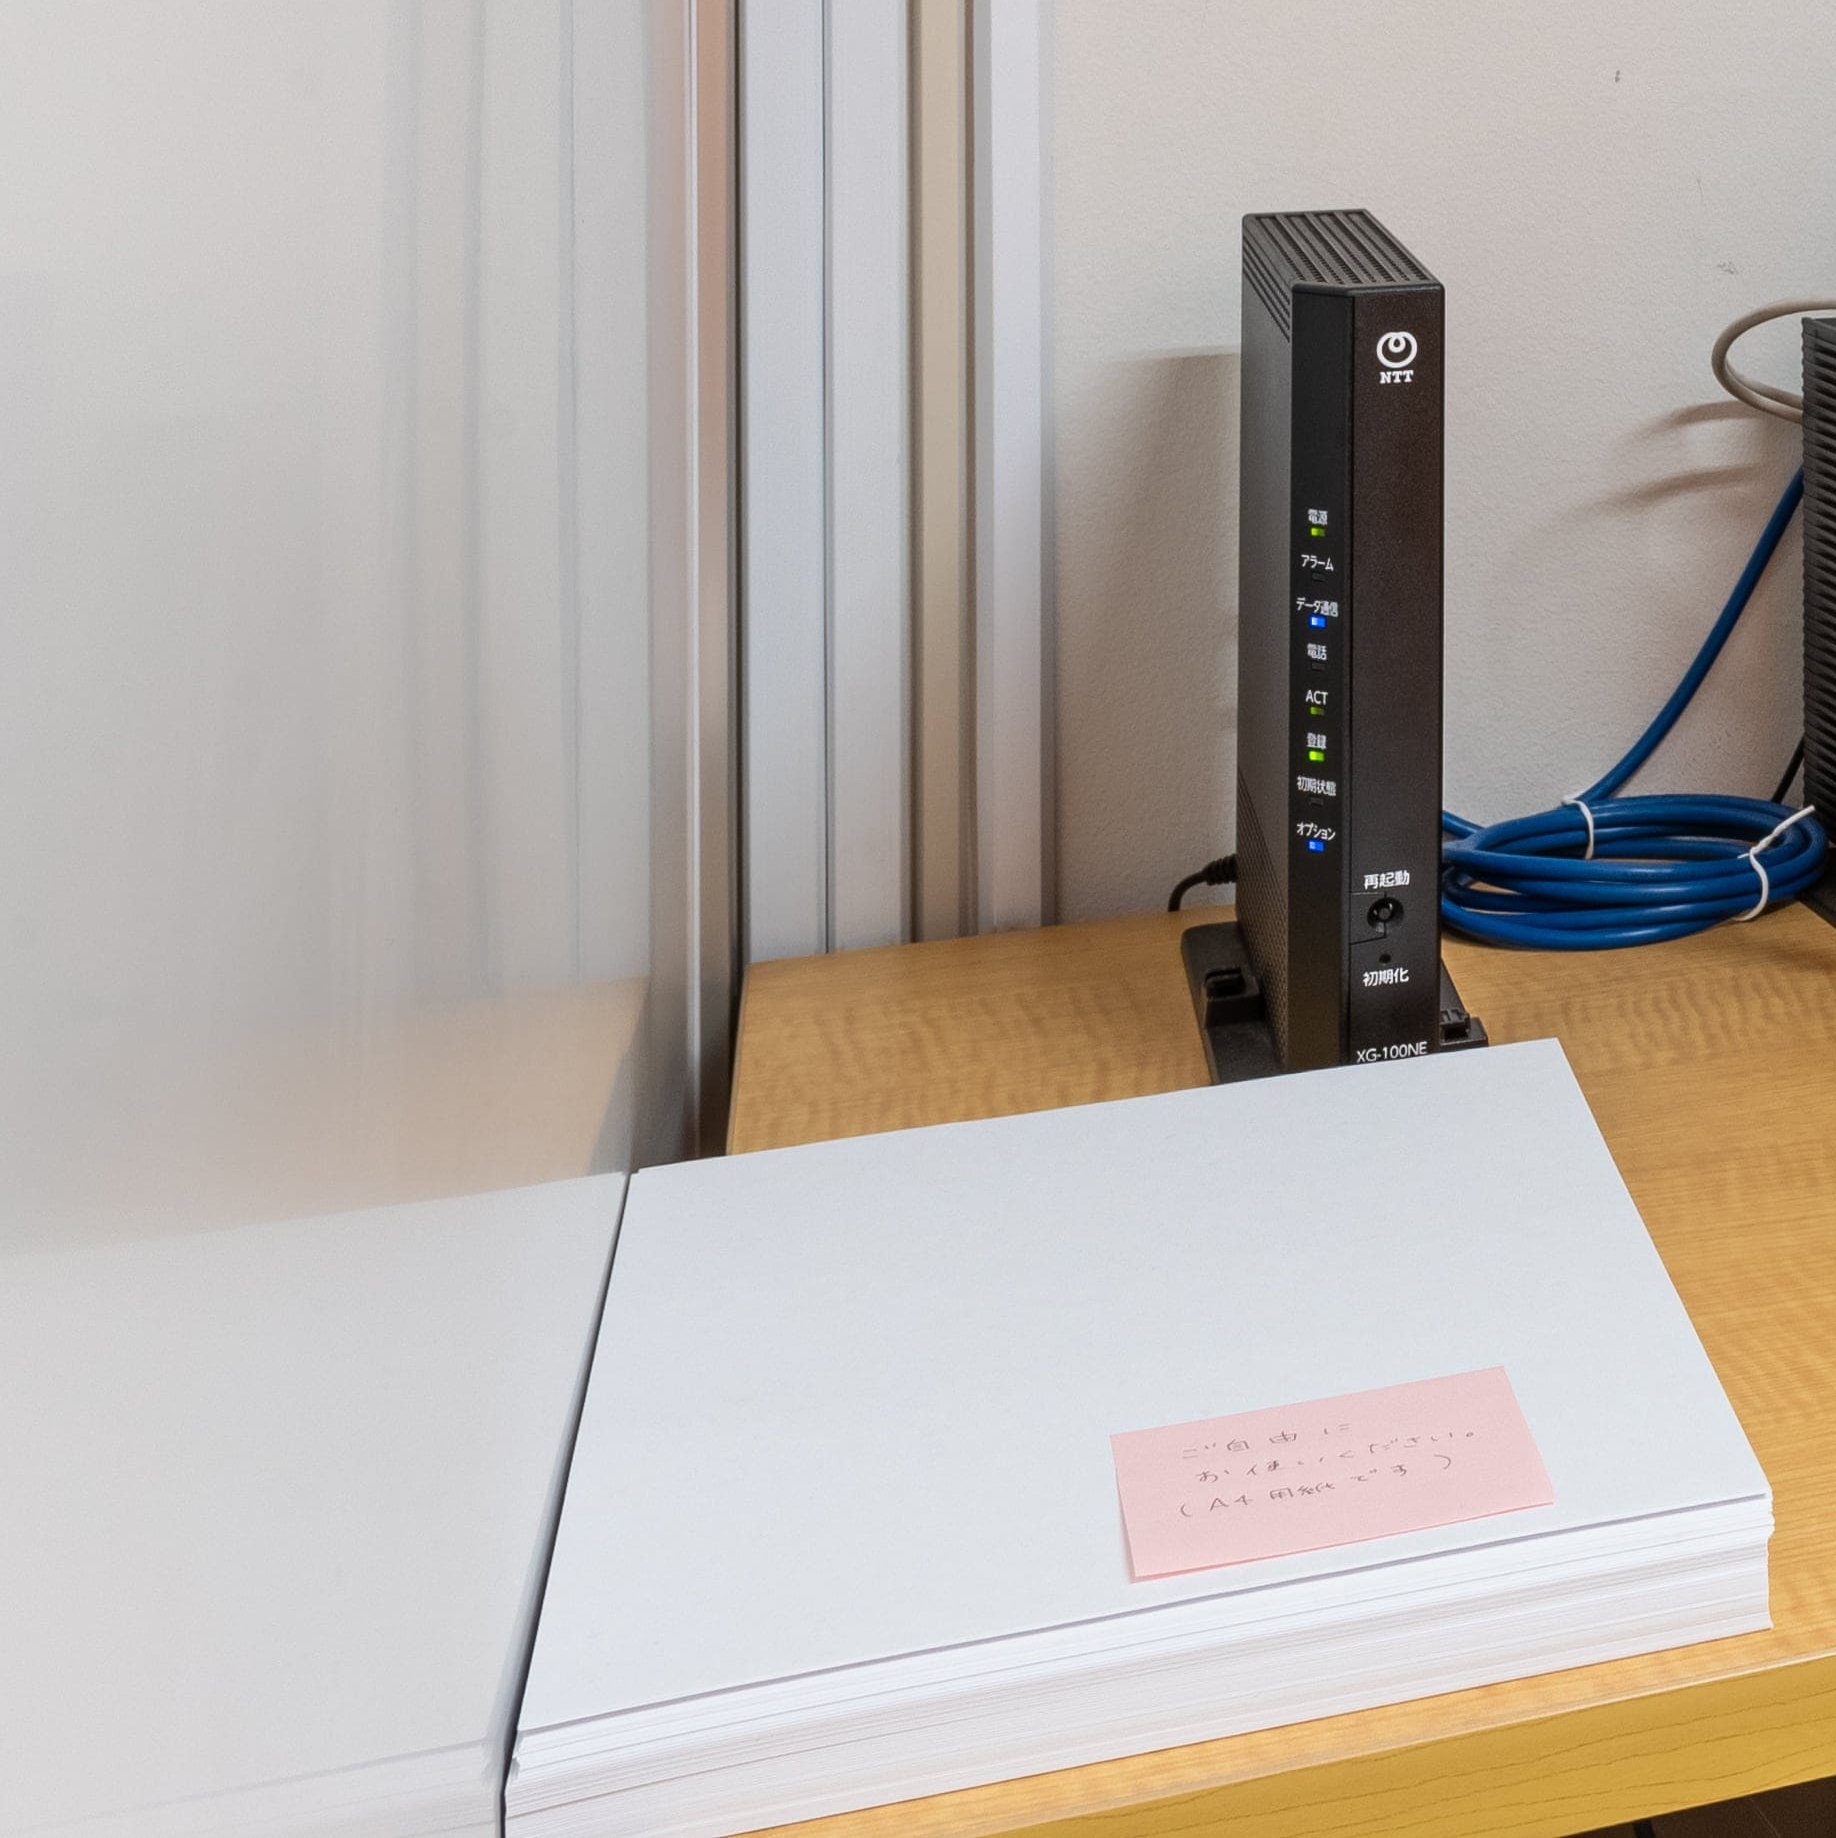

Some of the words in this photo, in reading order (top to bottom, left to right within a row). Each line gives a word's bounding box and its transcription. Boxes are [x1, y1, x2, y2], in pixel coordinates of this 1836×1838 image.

[1379, 369, 1414, 384] NTT
[1308, 509, 1328, 525] 電源
[1301, 554, 1334, 570] アラーム
[1296, 597, 1338, 616] データ通信
[1307, 644, 1328, 660] 電話
[1305, 689, 1328, 705] ACT
[1307, 733, 1327, 750] 登録
[1297, 776, 1336, 796] 初期状態
[1296, 822, 1336, 841] オプション
[1363, 870, 1410, 890] 再起動
[1363, 967, 1409, 986] 初期化
[1356, 1041, 1428, 1064] XG-100NE
[1181, 1422, 1351, 1459] ご自由に
